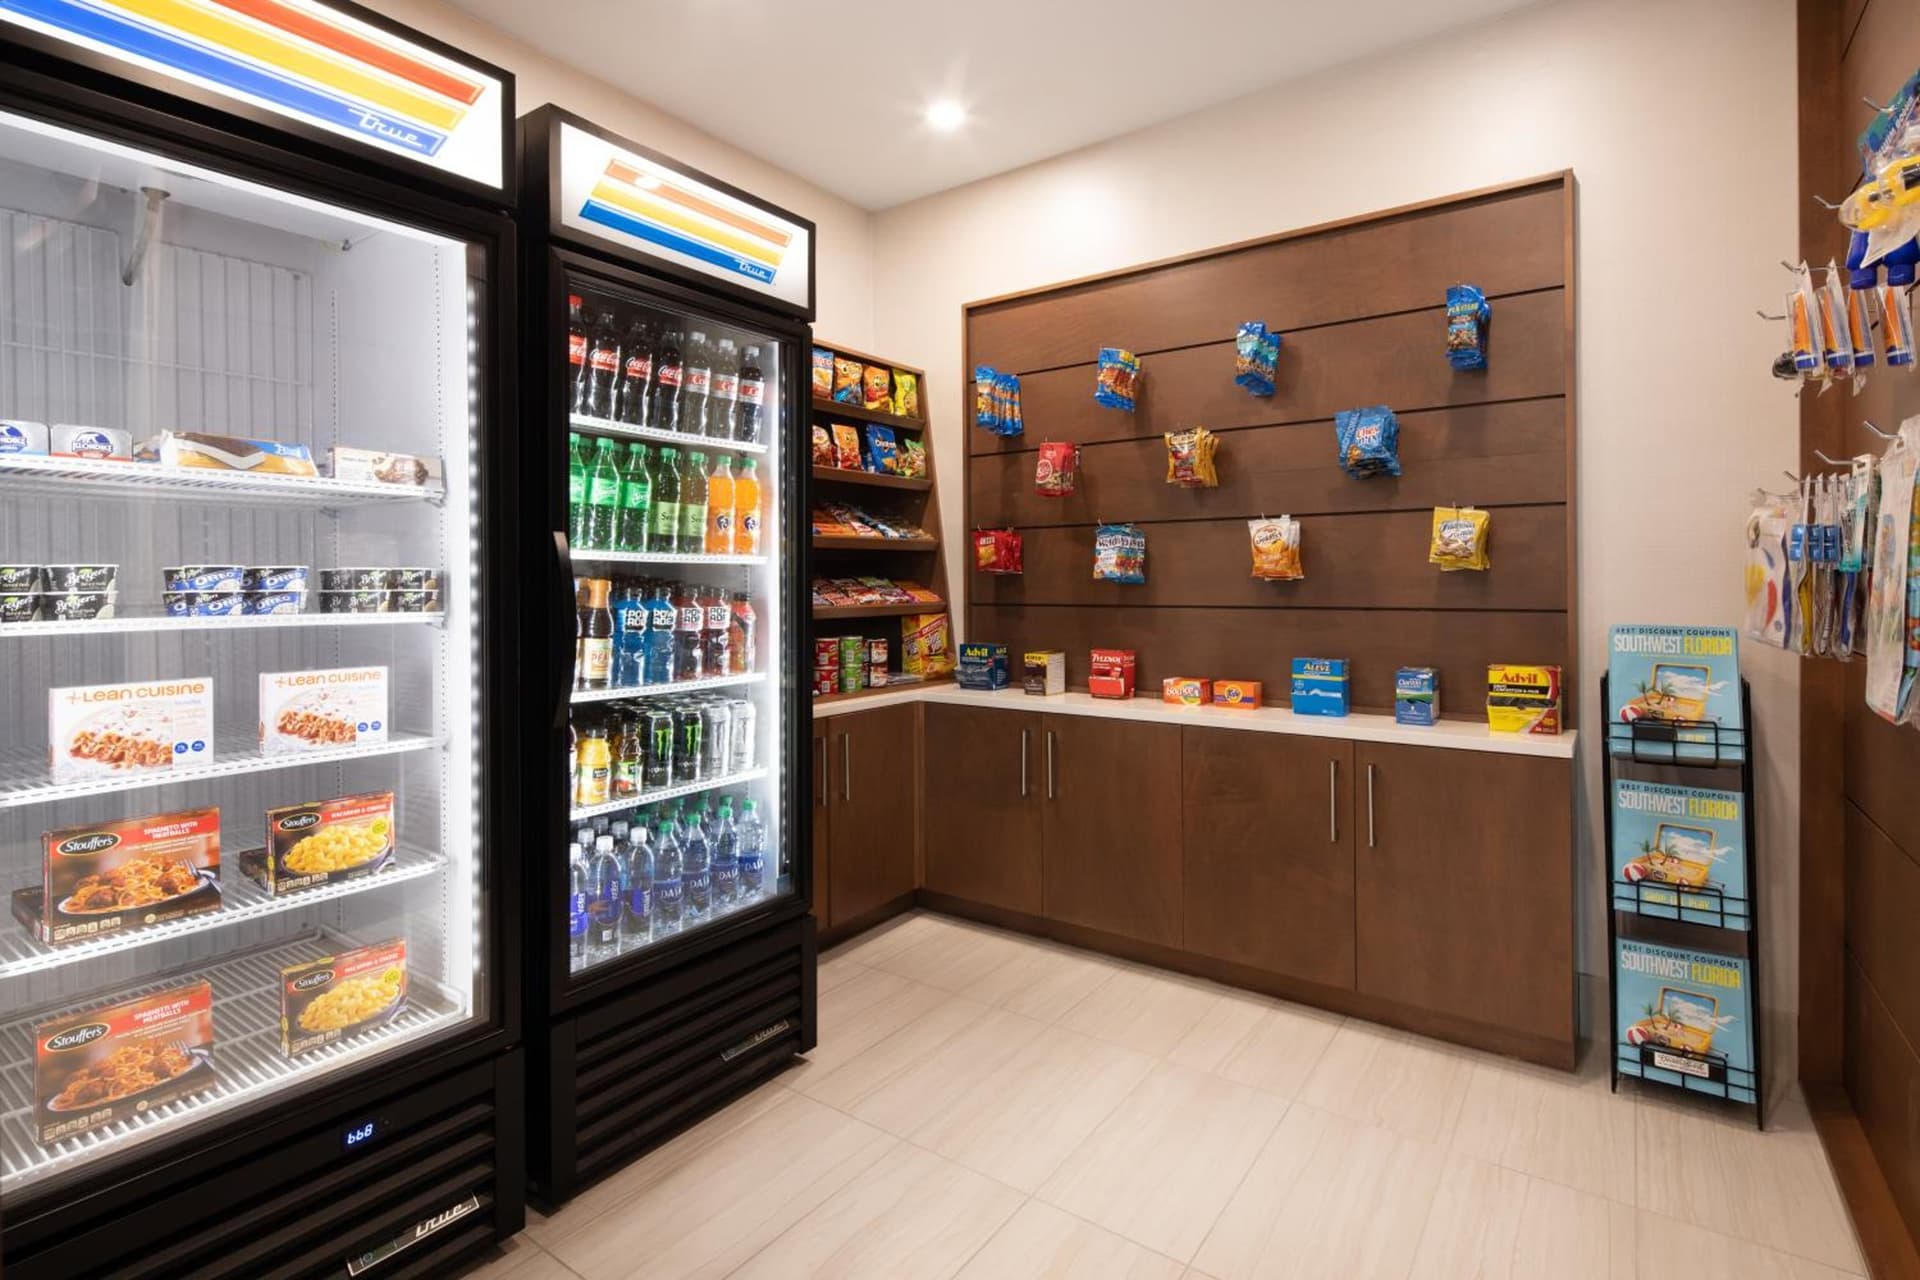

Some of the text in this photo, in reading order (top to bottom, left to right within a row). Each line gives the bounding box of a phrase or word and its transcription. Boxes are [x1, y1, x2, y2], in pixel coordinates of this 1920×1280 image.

[1639, 628, 1683, 636] DISCOUNT
[1686, 629, 1730, 637] COUPONS
[965, 647, 988, 657] Advil
[1614, 634, 1733, 656] SOUTHWEST FLORIDA
[1500, 672, 1537, 684] Advil
[1643, 785, 1688, 796] DISCOUNT
[1618, 790, 1739, 820] SOUTHWEST FLORIDA
[1645, 947, 1690, 961] DISCOUNT
[1694, 955, 1740, 969] COUPONS
[1621, 950, 1741, 988] SOUTHWEST FLORIDA
